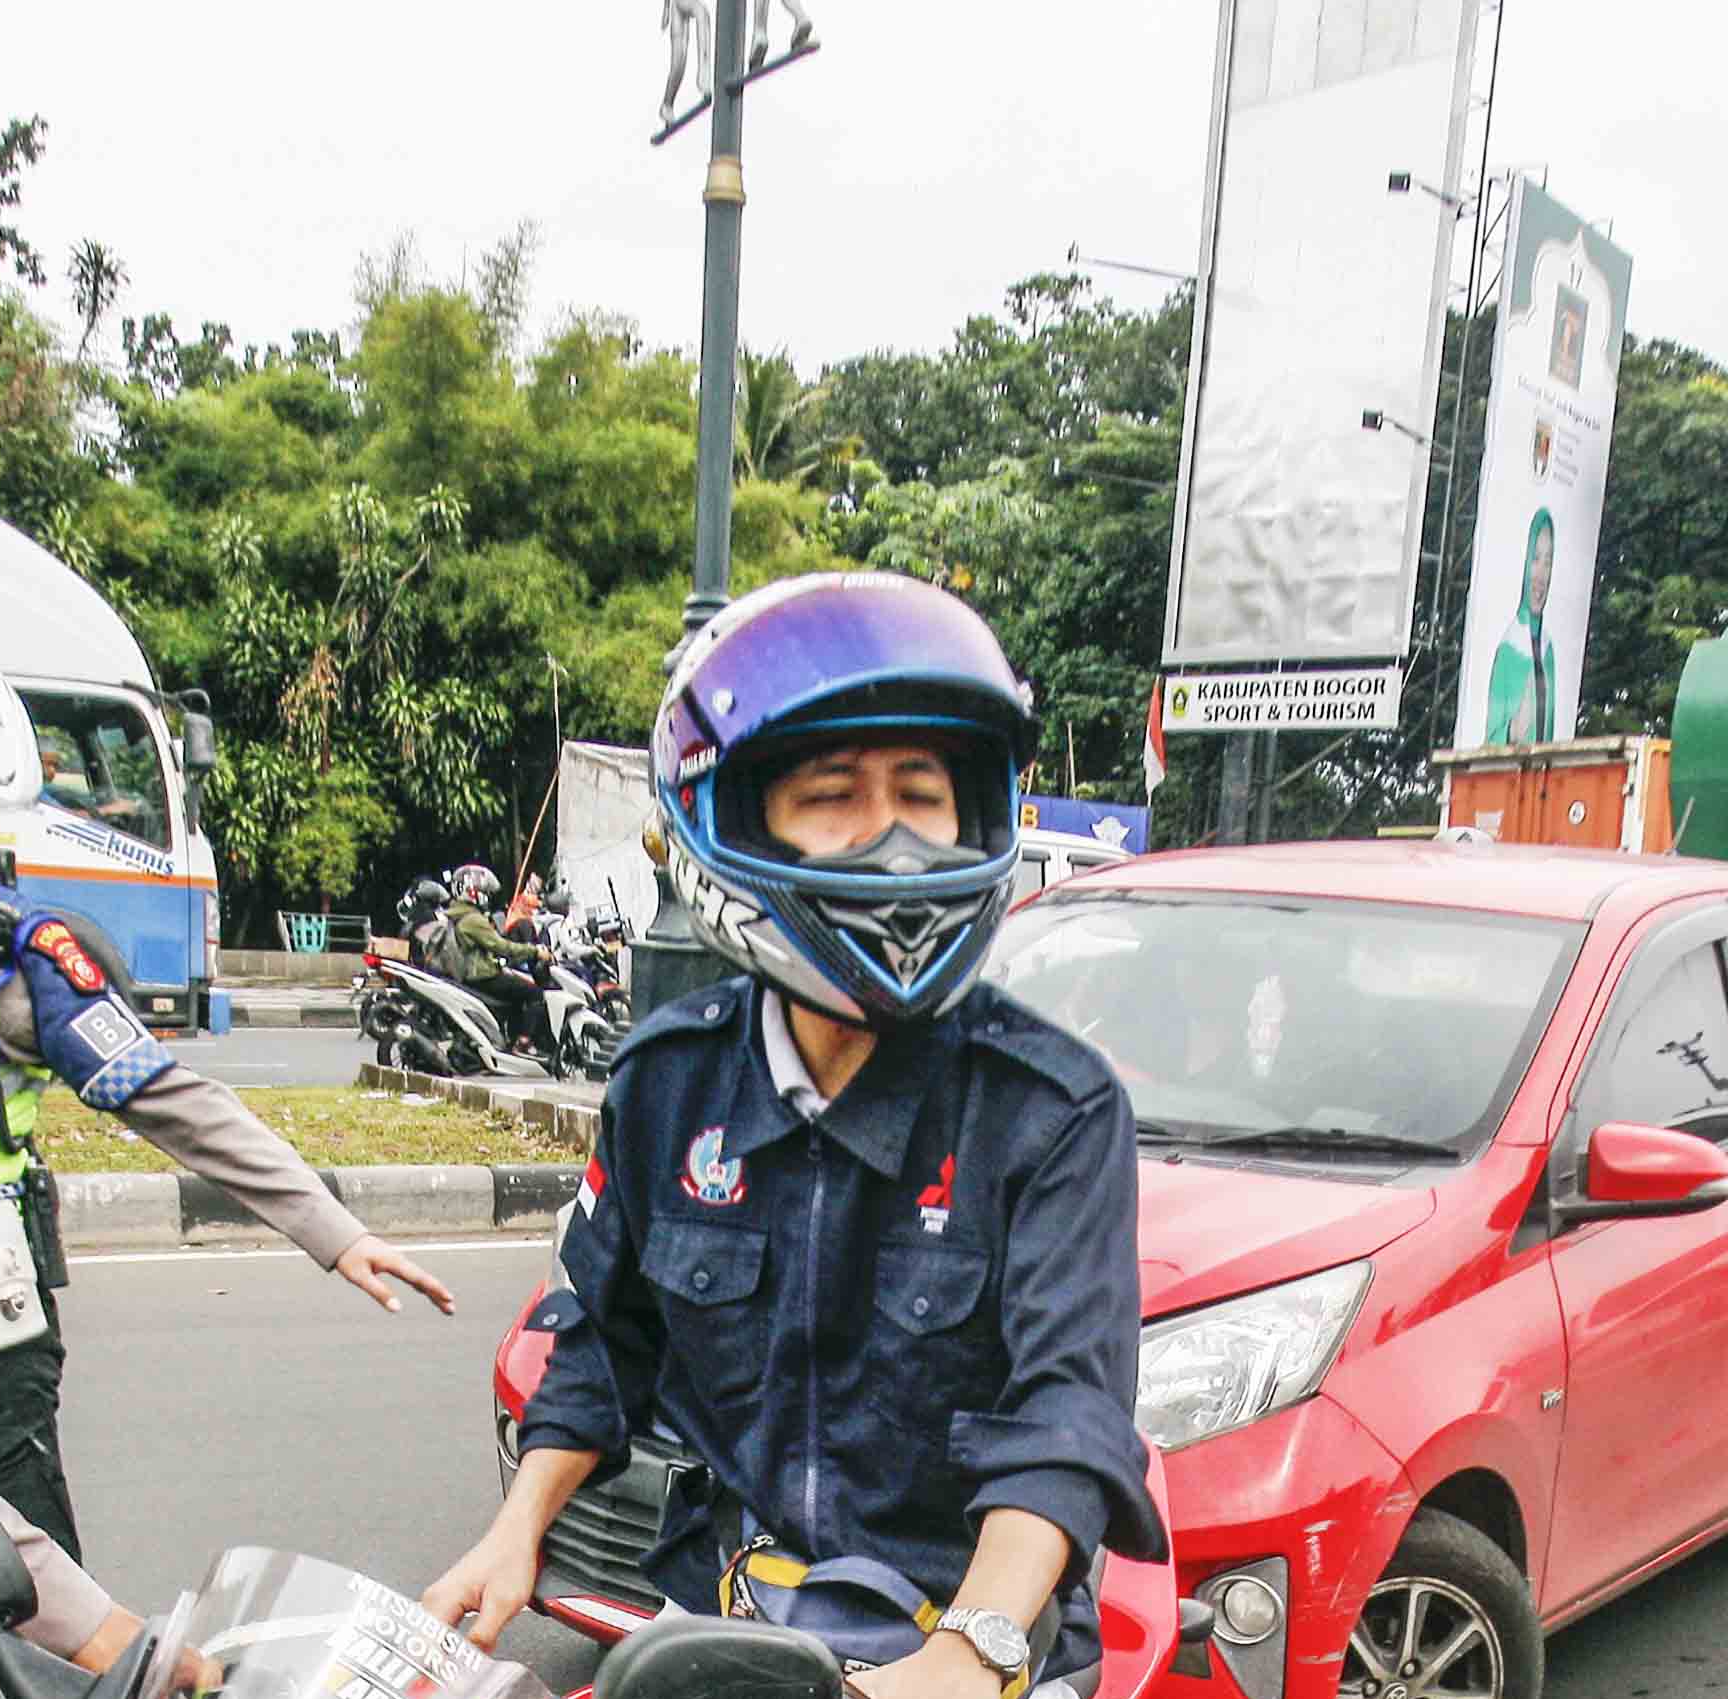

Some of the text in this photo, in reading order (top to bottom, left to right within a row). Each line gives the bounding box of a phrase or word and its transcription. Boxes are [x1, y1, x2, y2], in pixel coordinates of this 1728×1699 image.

[1198, 677, 1386, 700] KABUPATEN BOGOR
[1204, 701, 1376, 723] SPORT & TOURISM
[107, 830, 176, 875] kumis
[347, 1571, 484, 1673] MITSUBISHI
[354, 1598, 461, 1682] MOTORS
